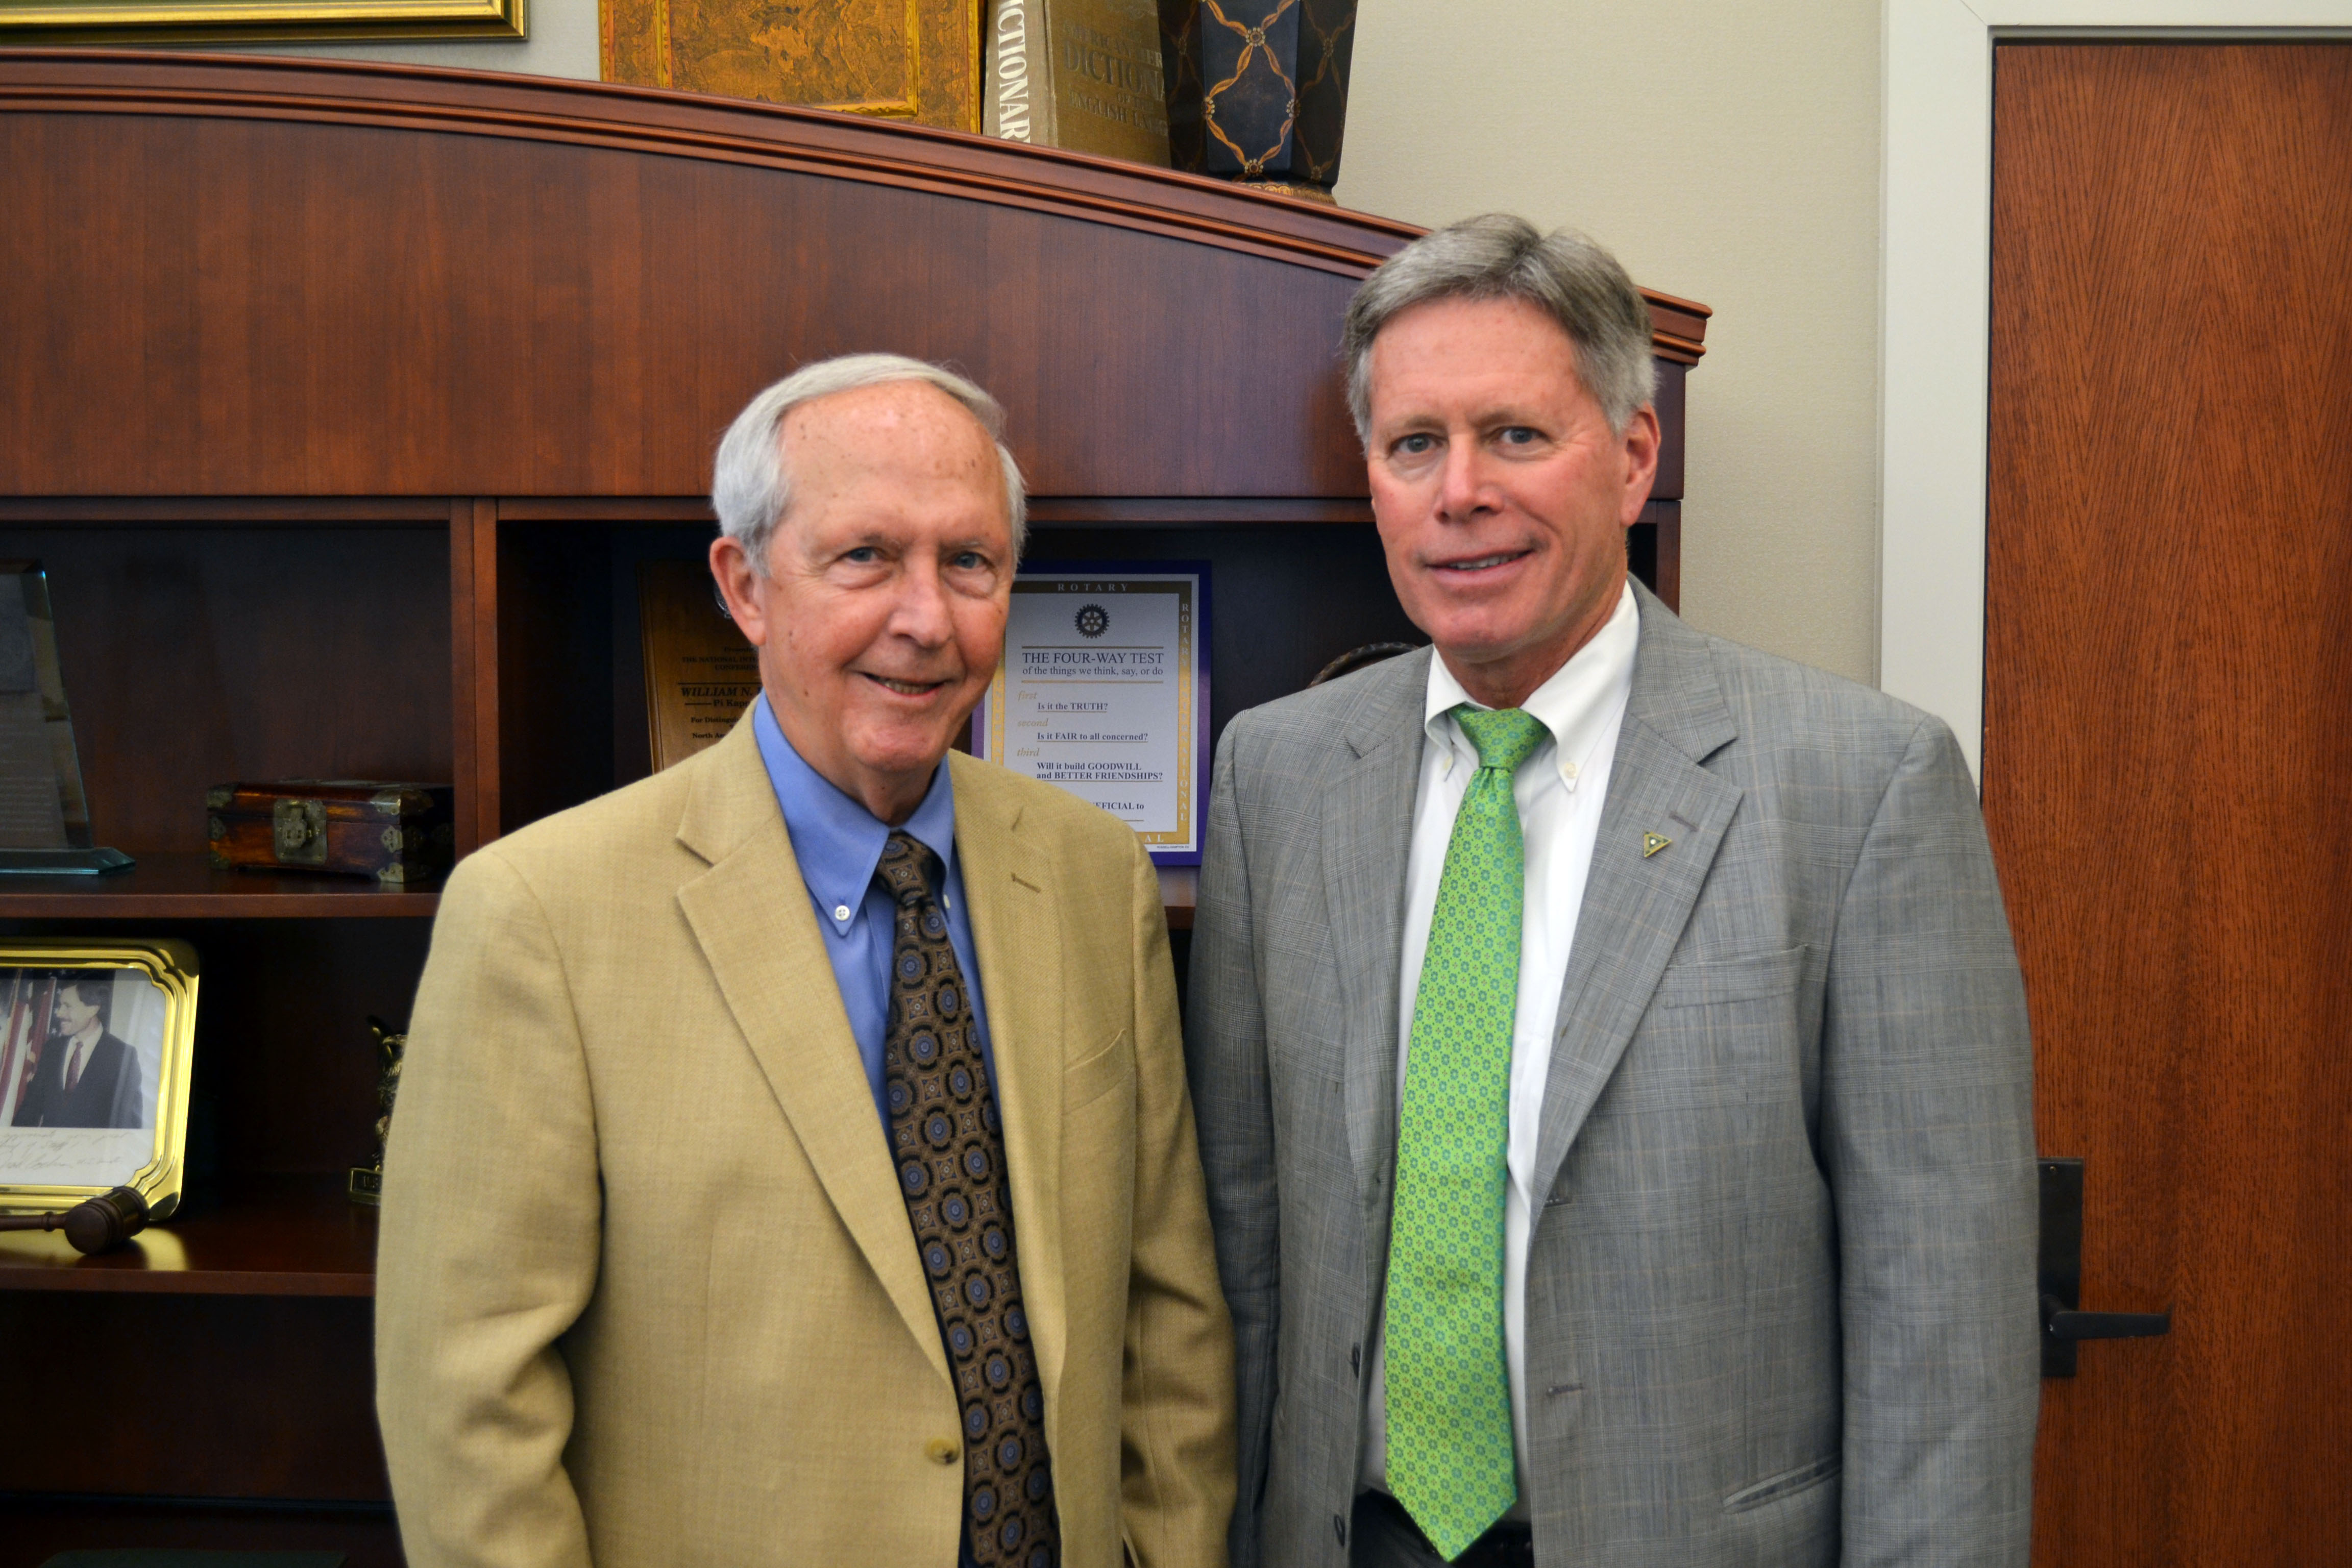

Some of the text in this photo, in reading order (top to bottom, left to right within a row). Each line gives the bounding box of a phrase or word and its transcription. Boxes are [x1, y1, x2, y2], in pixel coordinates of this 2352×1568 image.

[998, 0, 1031, 143] ICTIONAR
[1058, 583, 1129, 592] ROTARY
[1022, 652, 1164, 664] THE FOUR-WAY TEST
[1049, 667, 1076, 677] things
[1094, 667, 1119, 676] think,
[1152, 667, 1163, 675] do
[681, 687, 738, 696] WILLIAM
[740, 687, 752, 696] N.
[1018, 691, 1037, 701] first
[1180, 603, 1190, 821] ROTARY INTERNATIONAL
[1018, 718, 1048, 727] second
[1102, 732, 1148, 741] concerned?
[1017, 748, 1039, 757] third
